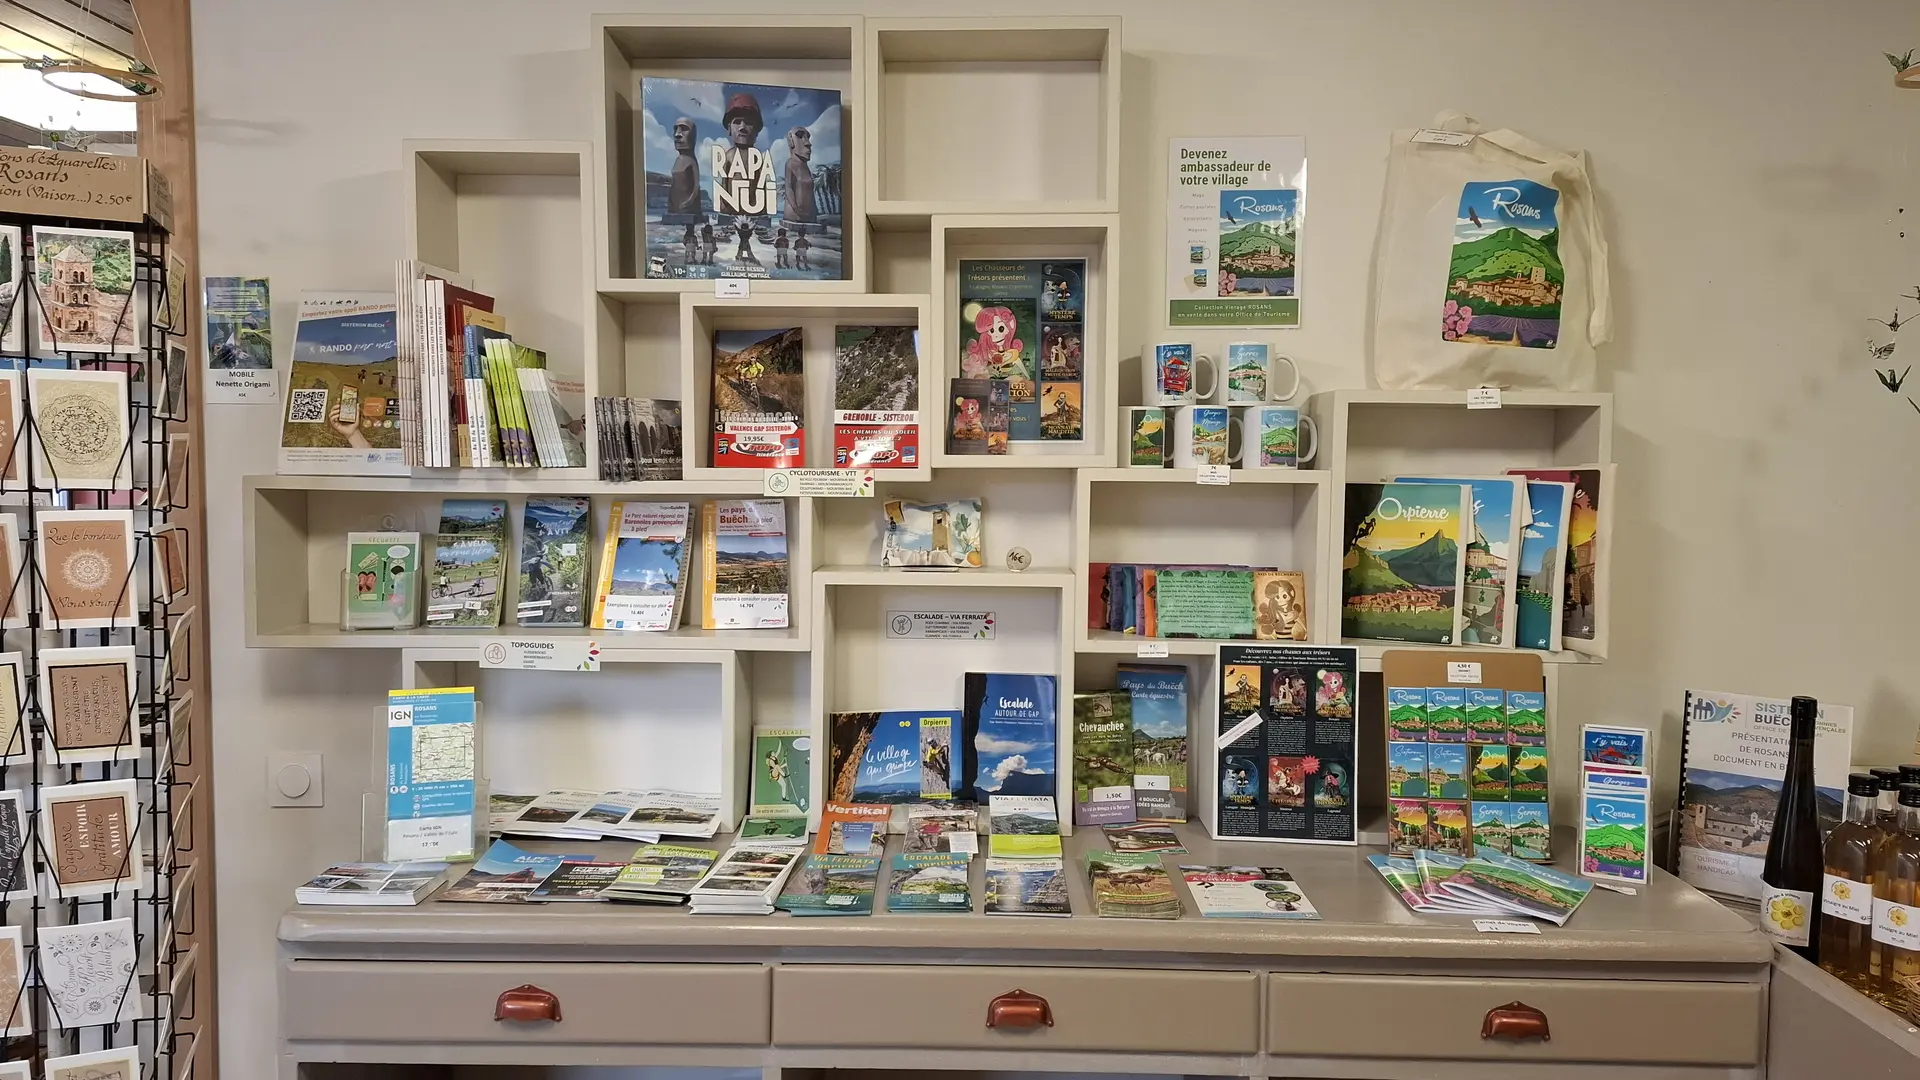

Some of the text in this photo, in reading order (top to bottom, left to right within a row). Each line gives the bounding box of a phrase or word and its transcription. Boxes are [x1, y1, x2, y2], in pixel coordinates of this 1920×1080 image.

[1180, 149, 1228, 159] Devenez
[711, 145, 776, 188] RAPA
[1180, 160, 1271, 172] ambassadeur de
[0, 163, 69, 183] Rosans
[1180, 173, 1249, 187] votre village
[1233, 195, 1287, 216] Rosans
[1483, 186, 1541, 219] Rosans
[319, 343, 353, 353] RANDO
[215, 380, 271, 389] Nenette Origami
[843, 413, 914, 421] GRENOBLE SISTERON
[730, 507, 746, 515] pays
[1377, 497, 1449, 522] Orpierre
[720, 514, 748, 524] Buëch
[71, 527, 81, 541] le
[82, 526, 122, 541] bonheur
[636, 525, 648, 533] pied
[468, 539, 487, 548] VÉLO
[1008, 551, 1024, 564] 16€
[511, 642, 554, 650] TOPOGUIDES
[1122, 679, 1184, 691] Pays du Buëch
[1131, 691, 1175, 701] Carte équestre
[1000, 696, 1034, 709] Escalade
[390, 710, 411, 721] IGN
[1755, 702, 1825, 719] SISTEN
[923, 718, 948, 726] Orpierre
[1754, 712, 1791, 726] BUËC
[1079, 721, 1125, 733] Chevauchée
[1610, 738, 1628, 746] vais
[1731, 732, 1790, 747] PRÉSENTATI
[877, 745, 912, 763] village
[1739, 745, 1790, 758] DE ROSANS
[1713, 754, 1761, 768] DOCUMENT
[826, 803, 888, 815] Vertikal
[1596, 803, 1636, 819] Rosans
[76, 803, 90, 848] ESPOIR
[108, 812, 121, 859] AMOUR
[813, 854, 875, 865] VIA FERRATA
